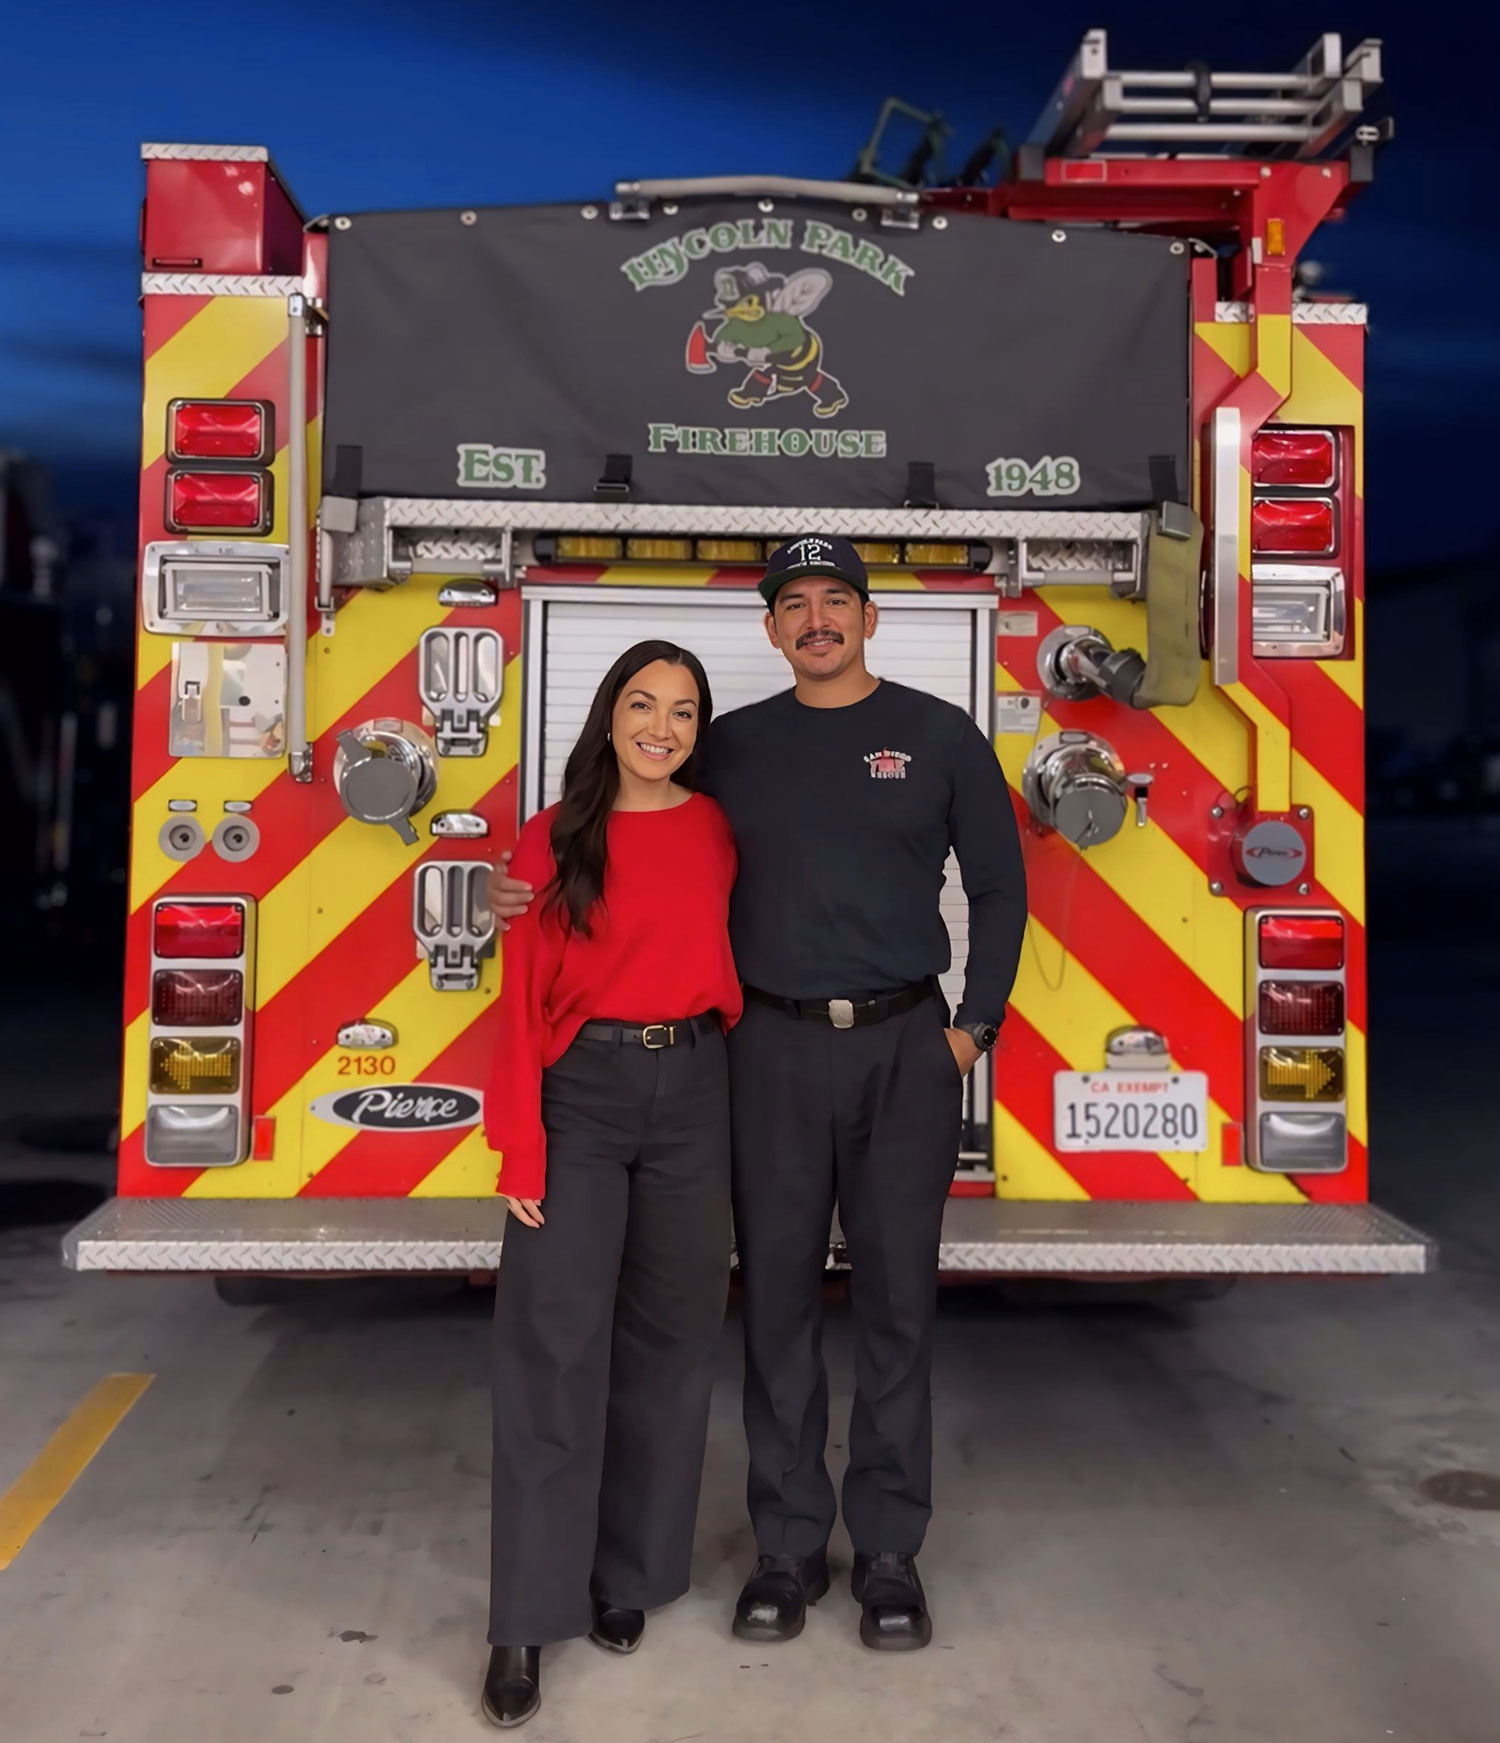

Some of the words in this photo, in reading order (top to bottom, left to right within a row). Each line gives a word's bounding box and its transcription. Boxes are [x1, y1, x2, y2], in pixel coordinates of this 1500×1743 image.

[800, 219, 915, 296] PARK
[648, 423, 887, 458] FIREHOUSE
[457, 443, 547, 489] EST.
[985, 455, 1081, 497] 1948
[799, 544, 821, 561] 12
[337, 1056, 396, 1075] 2130
[1090, 1082, 1110, 1093] CA
[1116, 1082, 1169, 1094] EXEMPT
[351, 1090, 459, 1123] Pierce
[1066, 1103, 1198, 1139] 1520280
